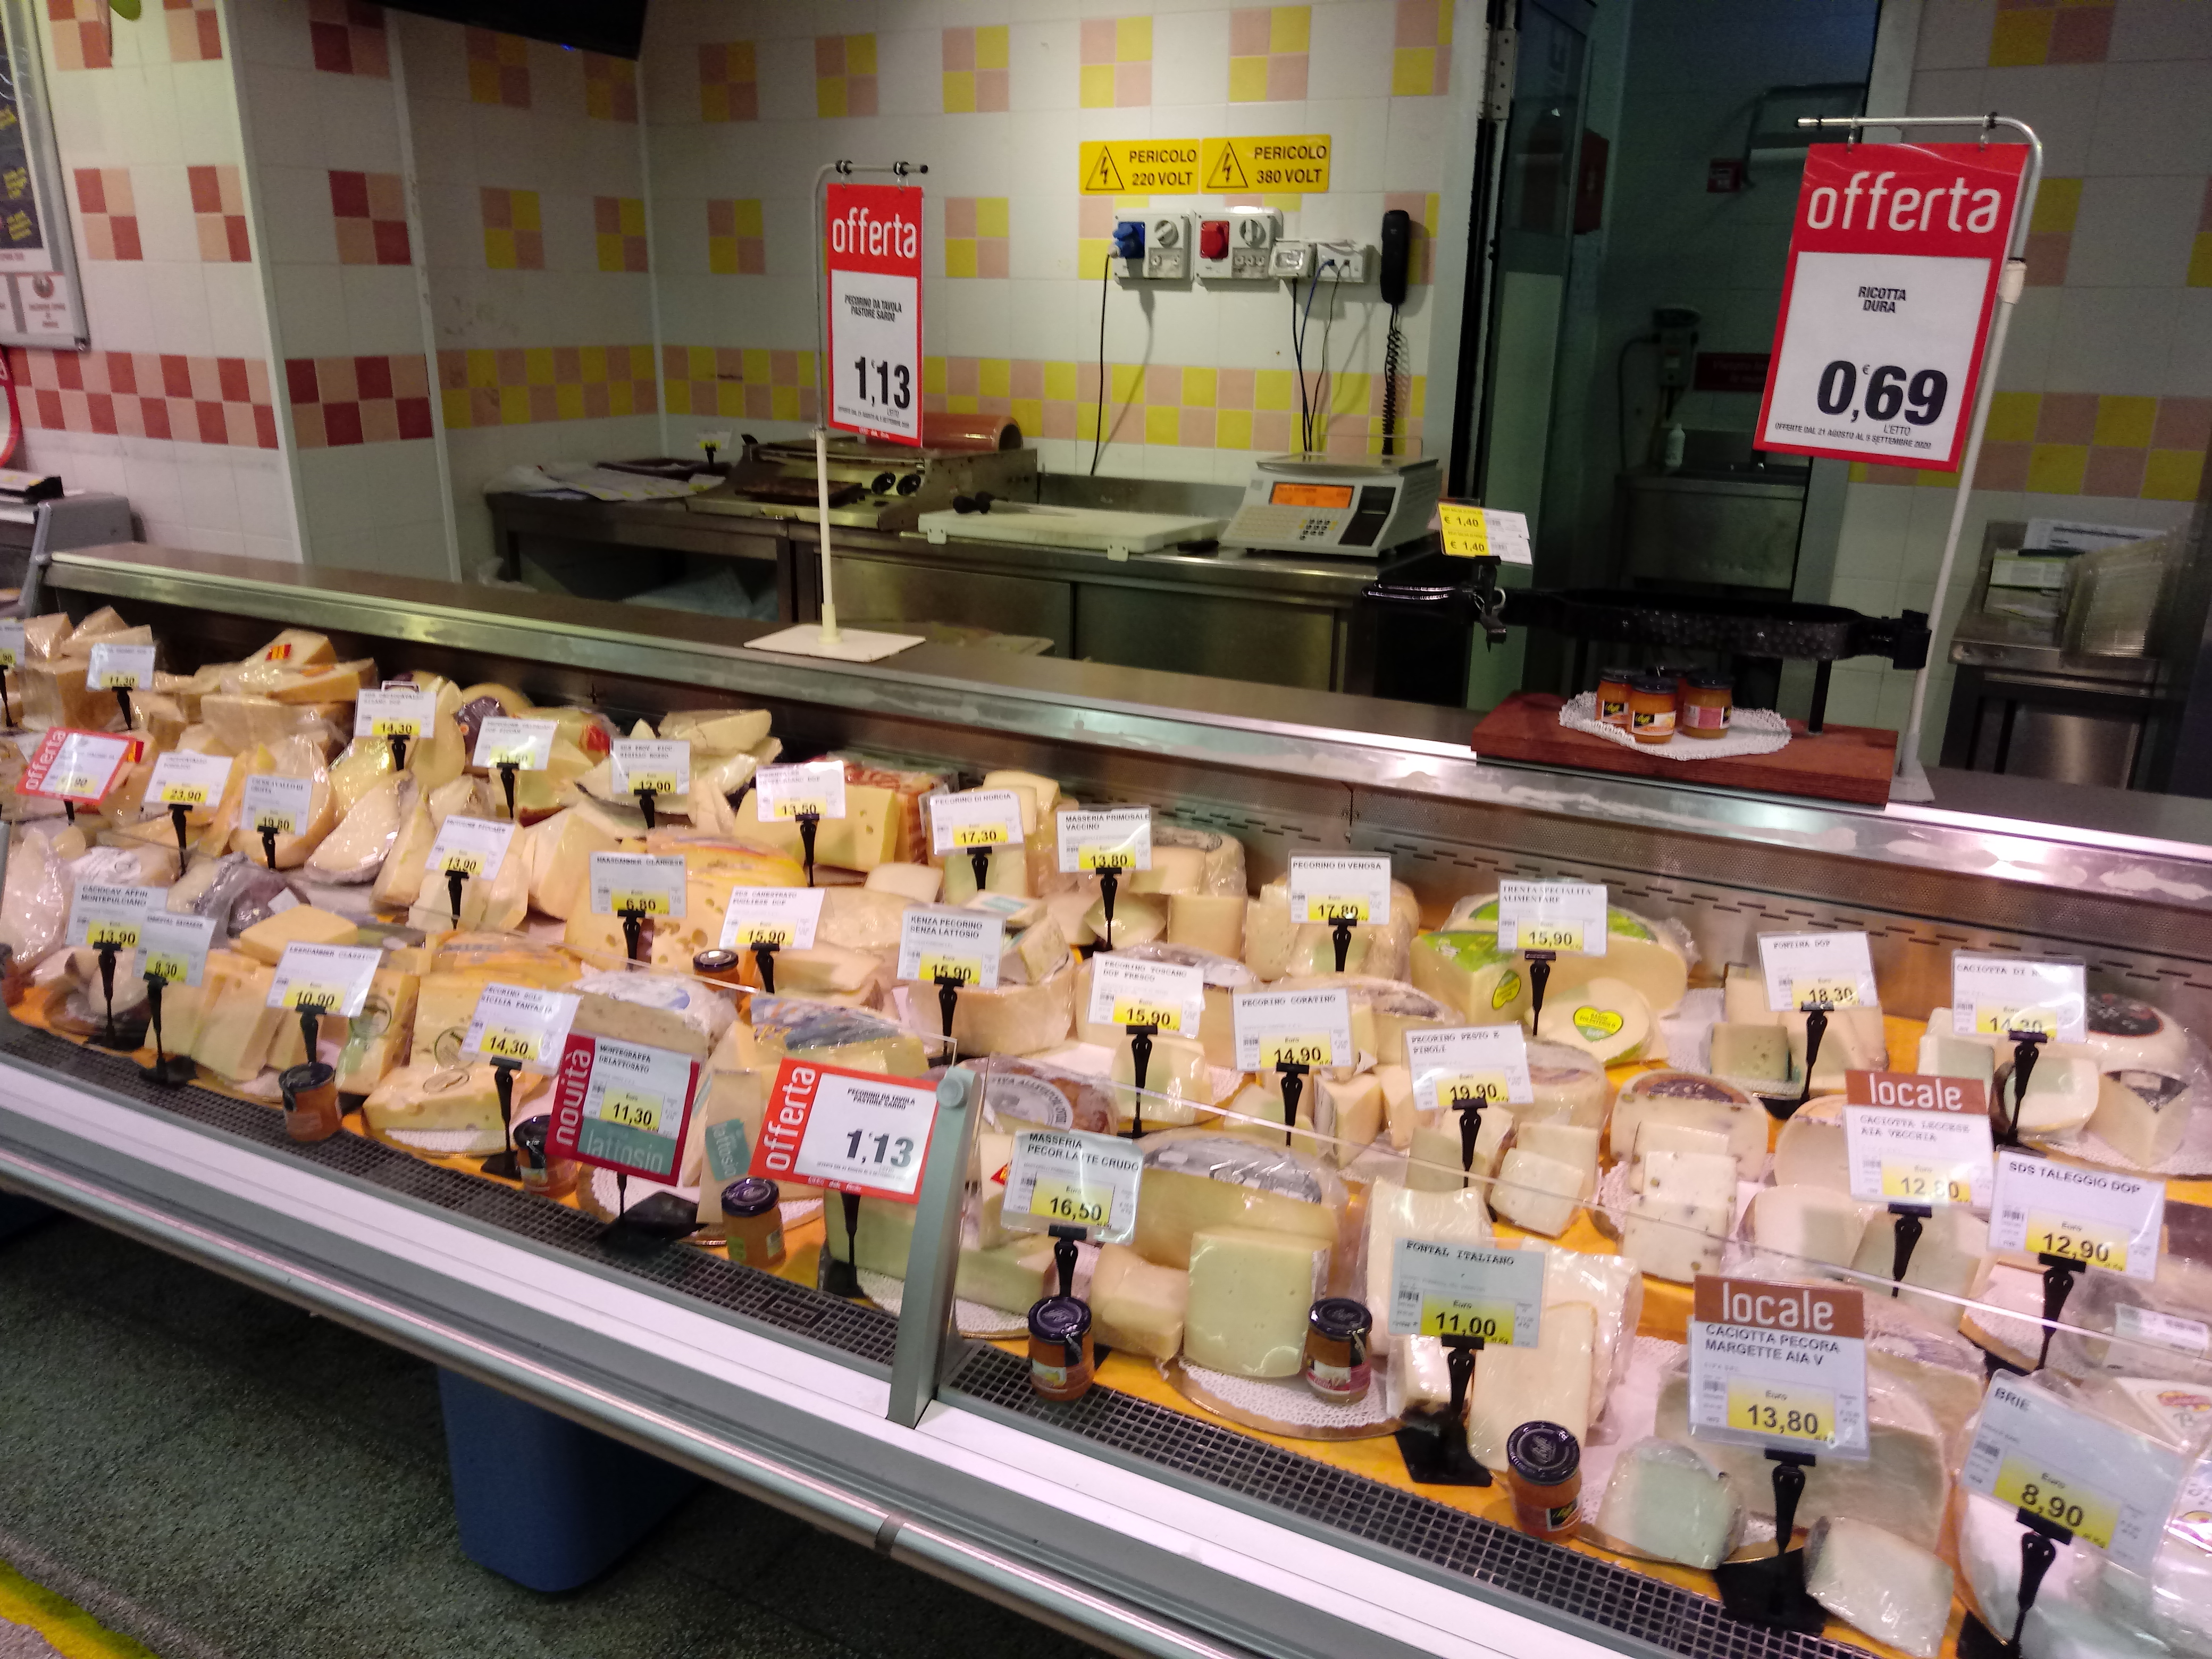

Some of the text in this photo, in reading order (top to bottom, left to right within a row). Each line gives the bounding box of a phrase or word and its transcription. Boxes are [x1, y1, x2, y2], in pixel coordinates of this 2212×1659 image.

[1129, 149, 1196, 163] PERICOLO
[1254, 145, 1326, 160] PERICOLO
[1132, 172, 1193, 186] 220 VOLT
[1256, 168, 1322, 184] 380 VOLT
[1807, 171, 2001, 234] offerta
[832, 207, 917, 258] offerta
[1858, 286, 1907, 301] RICOTTA
[844, 294, 871, 308] PECORINO
[881, 299, 902, 313] TAVOLA
[1863, 300, 1896, 314] DURA
[876, 310, 895, 322] SARDO
[935, 797, 972, 805] PECORINO
[984, 792, 1011, 801] NORCIA
[1066, 813, 1150, 823] MASSERIA PRIMOSALE
[1293, 861, 1381, 870] PECORINO DI VENOSA
[1503, 885, 1537, 894] TRENTA
[1502, 894, 1561, 904] ALIMENTARE
[911, 915, 983, 931] KENZA PECORINO
[910, 925, 979, 940] SENZA LATTOSIO
[1529, 930, 1572, 949] 15,90
[1773, 939, 1830, 950] FONTINA DOP
[932, 963, 971, 981] 1590
[1103, 969, 1155, 982] DOP FRESCO
[1104, 959, 1187, 978] PECORINO TOSCANO
[1957, 963, 2007, 975] CACIOTTA
[2013, 968, 2025, 977] DI
[485, 986, 520, 998] PECORINO
[1242, 994, 1336, 1007] PECORINO CORATINO
[1809, 986, 1854, 1003] 1830
[1127, 1007, 1170, 1026] 15,90
[490, 1035, 529, 1054] 14,30
[1411, 1033, 1455, 1044] PECORINO
[1461, 1030, 1488, 1041] PESTO
[600, 1044, 651, 1063] MONTEGRAPPA
[1274, 1046, 1321, 1065] 14,90
[1413, 1044, 1446, 1054] PINOLI
[599, 1055, 649, 1074] DELATTOSATO
[847, 1087, 880, 1099] PECORINO
[892, 1094, 915, 1105] TAVOLA
[1869, 1073, 1963, 1111] locale
[614, 1102, 652, 1126] 11,30
[764, 1066, 816, 1171] offerta
[1860, 1115, 1970, 1133] CACIOTTA LECCESE
[1029, 1132, 1083, 1149] MASSERIA
[1861, 1126, 1938, 1142] AIA VECCHIA
[1101, 1156, 1138, 1171] CRUDO
[2009, 1161, 2140, 1194] SDS TALEGGIO DOP
[1900, 1176, 1959, 1199] 1280
[1050, 1196, 1102, 1221] 16,50
[1406, 1240, 1515, 1267] FONTAL ITALIANO
[2043, 1232, 2110, 1262] 12,90
[1723, 1281, 1833, 1331] locale
[1436, 1311, 1496, 1337] 11,00
[1706, 1323, 1841, 1354] CACIOTTA PECORA
[1706, 1338, 1824, 1366] MARGETTE AIA V
[1994, 1386, 2032, 1412] BRIE
[1747, 1404, 1819, 1435] 13,80
[2020, 1482, 2084, 1528] 8,90
